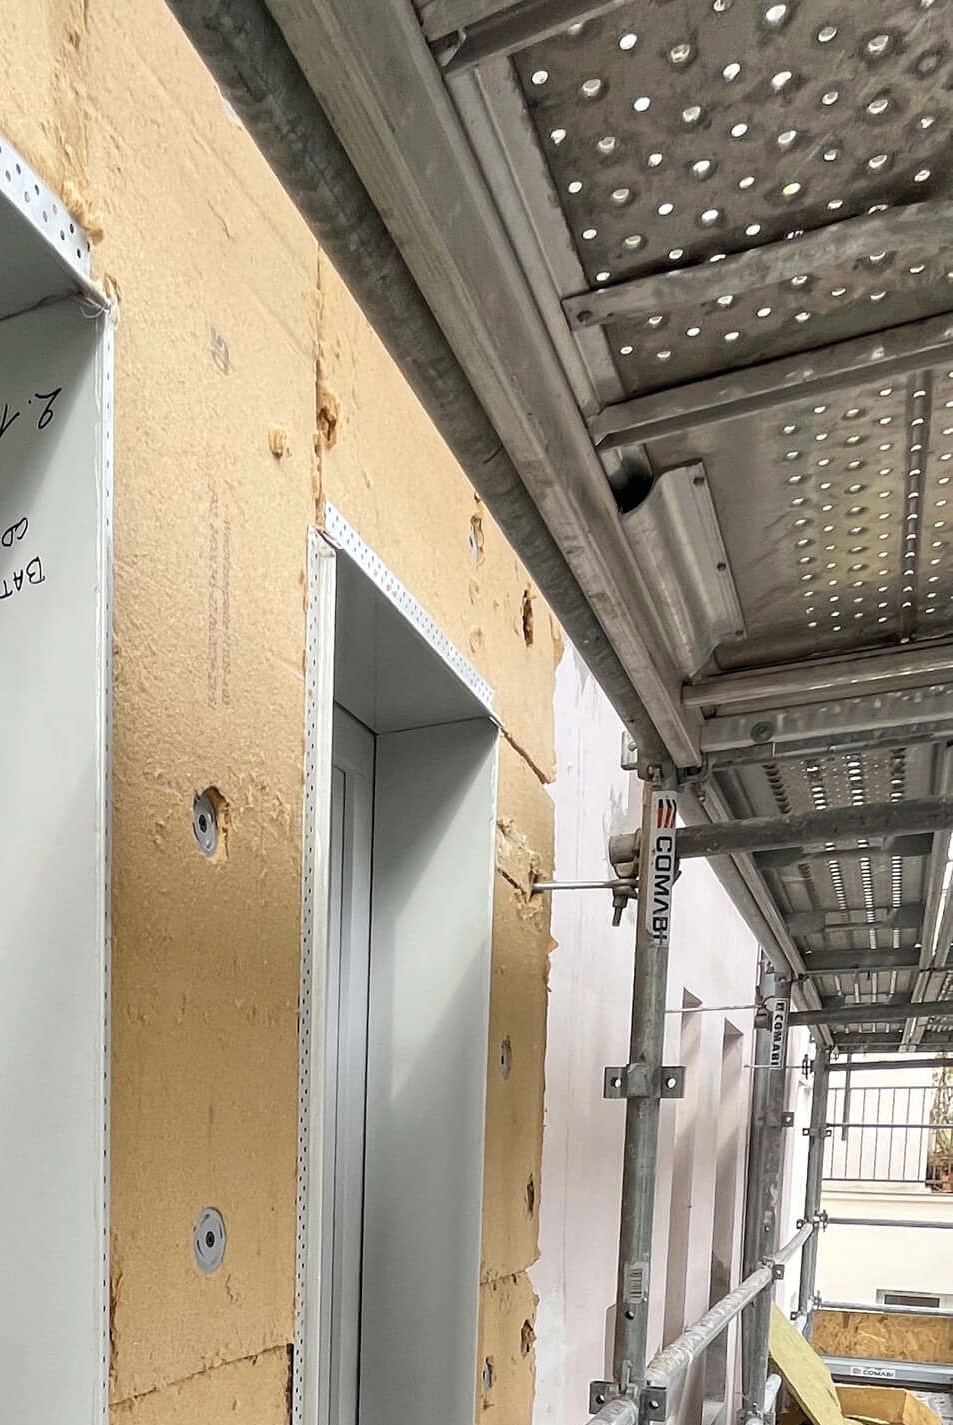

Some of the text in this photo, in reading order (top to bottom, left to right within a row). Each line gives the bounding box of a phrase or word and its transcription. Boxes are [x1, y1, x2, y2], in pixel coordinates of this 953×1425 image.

[651, 835, 673, 941] COMABI
[770, 1013, 784, 1066] COMABI
[862, 1369, 894, 1377] COMABI
